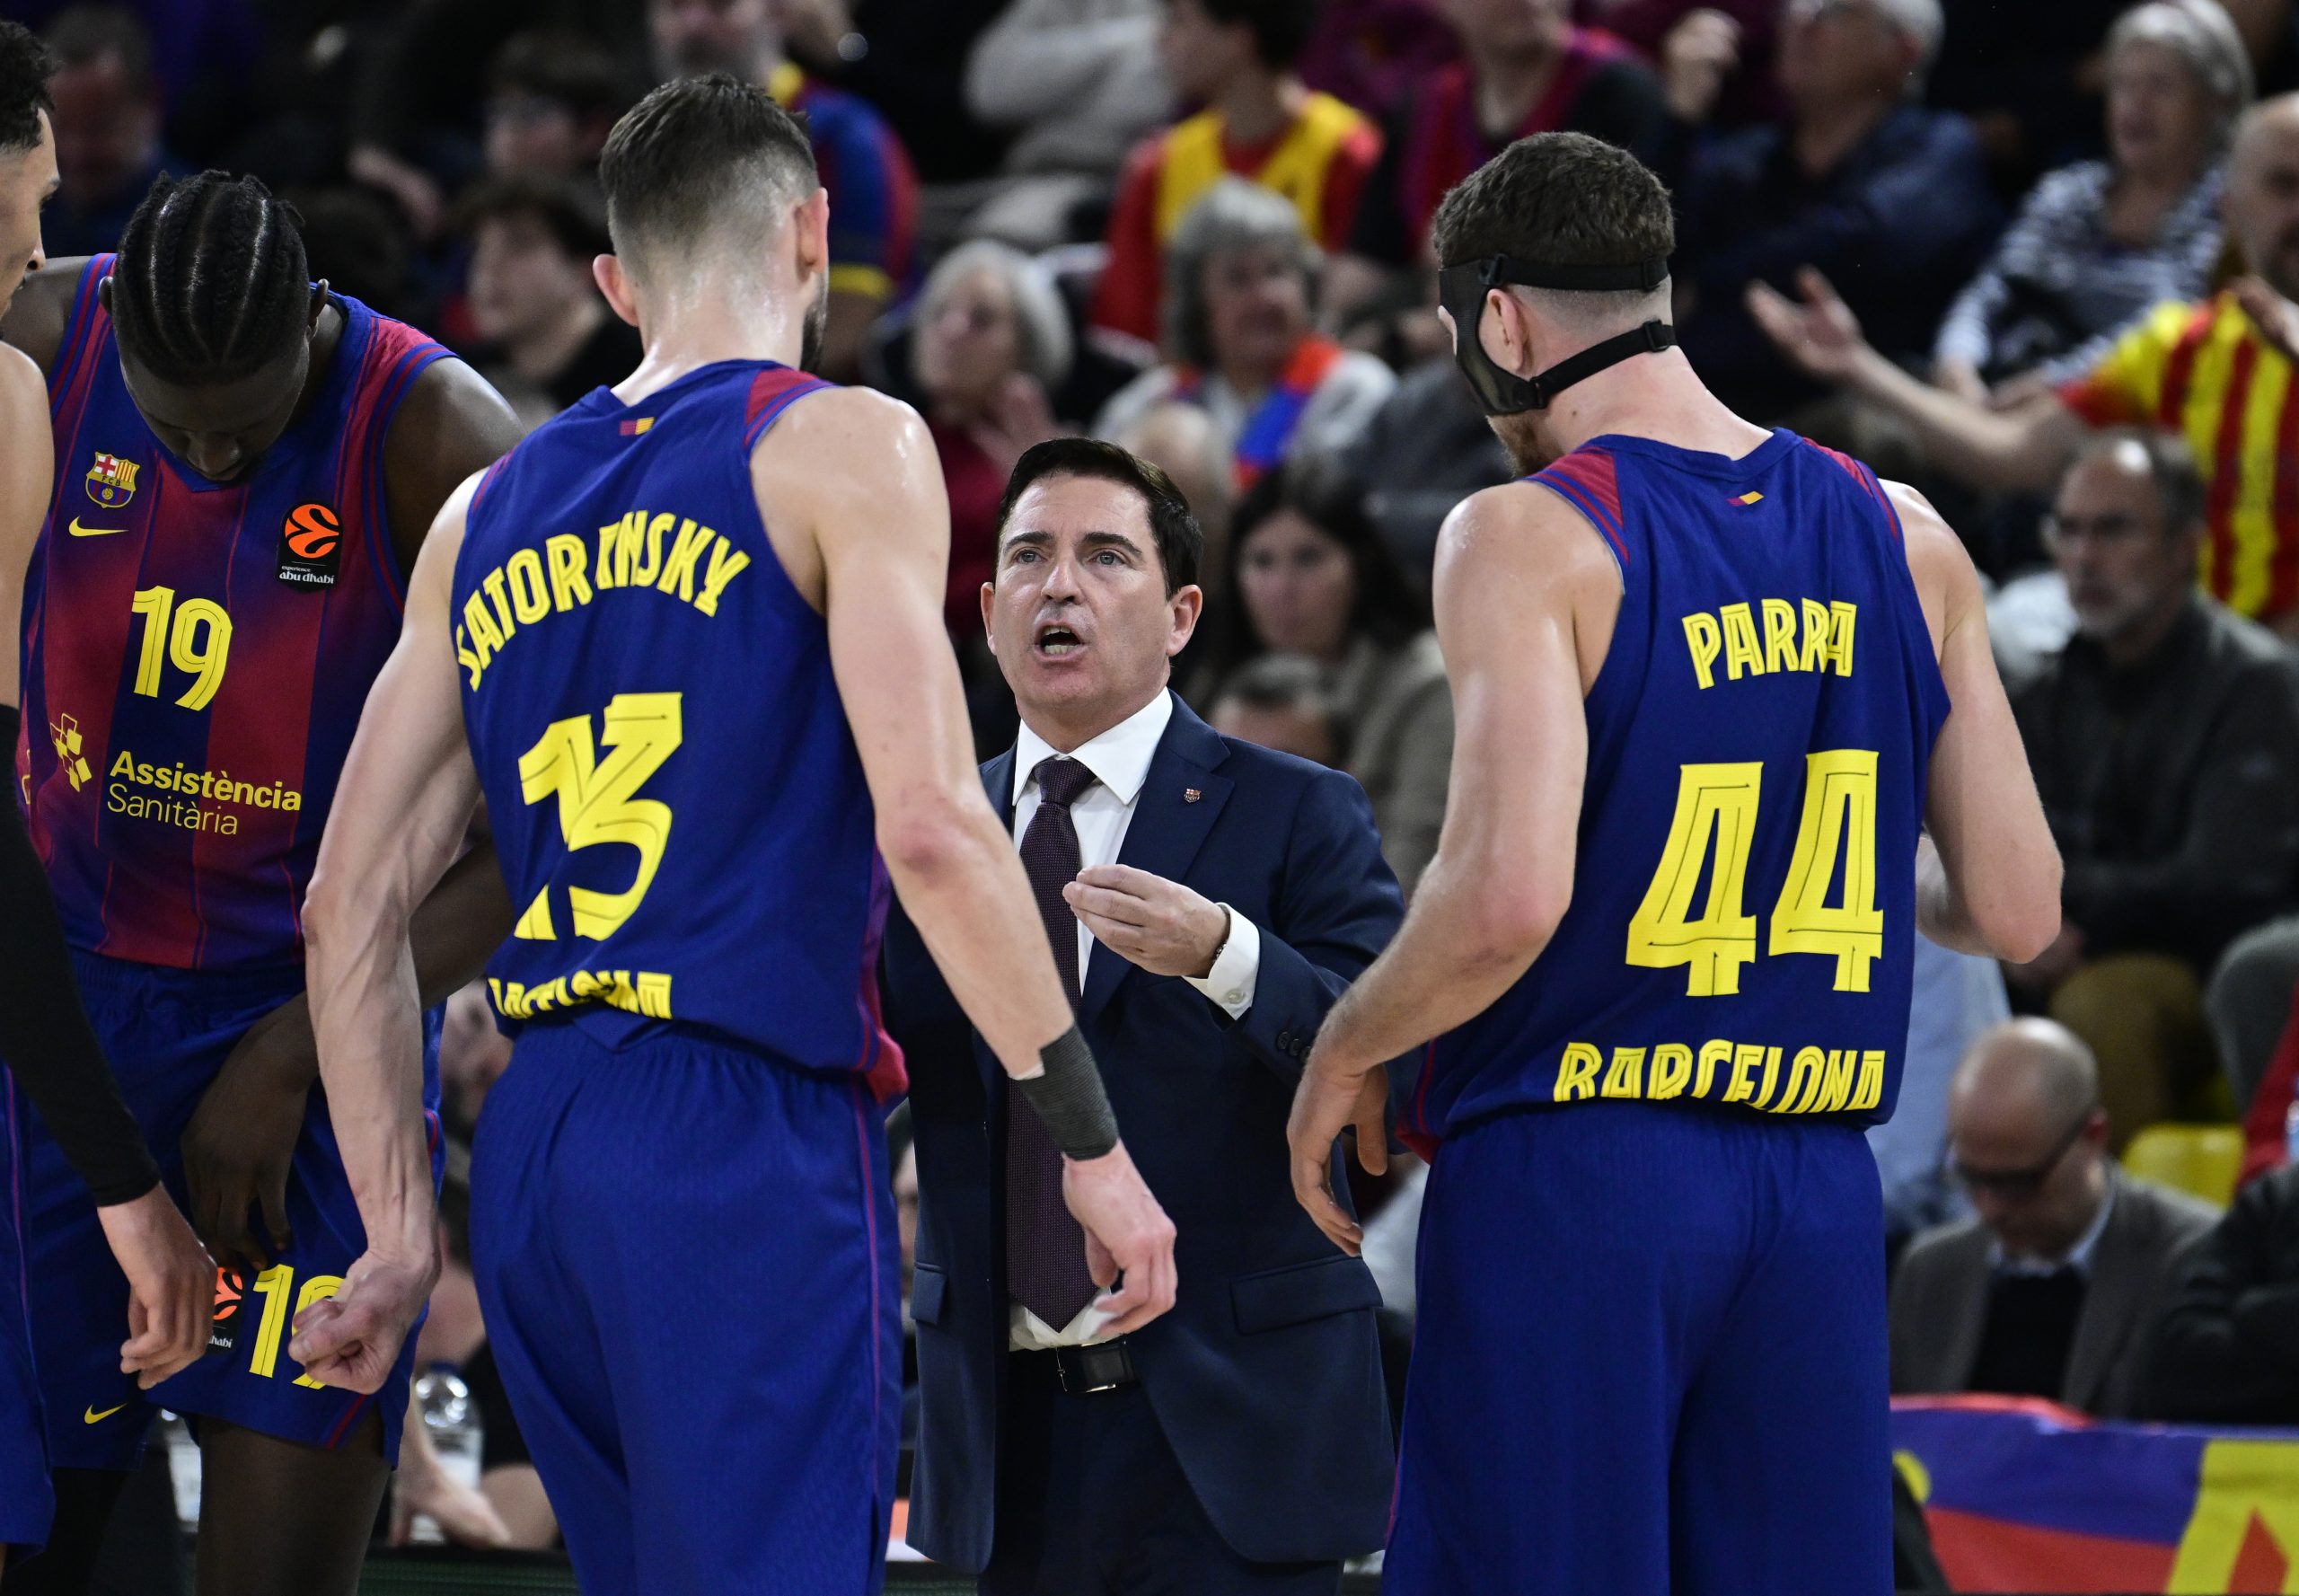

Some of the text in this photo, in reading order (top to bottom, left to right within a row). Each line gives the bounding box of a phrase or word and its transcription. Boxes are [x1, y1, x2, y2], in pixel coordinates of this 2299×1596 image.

[278, 570, 335, 585] abu dhabi
[132, 586, 233, 711] 19
[1681, 598, 1857, 690] PARRA
[107, 783, 238, 835] Sanitària
[110, 750, 302, 811] Assistència
[514, 692, 683, 941] 13
[1625, 749, 1884, 997] 44
